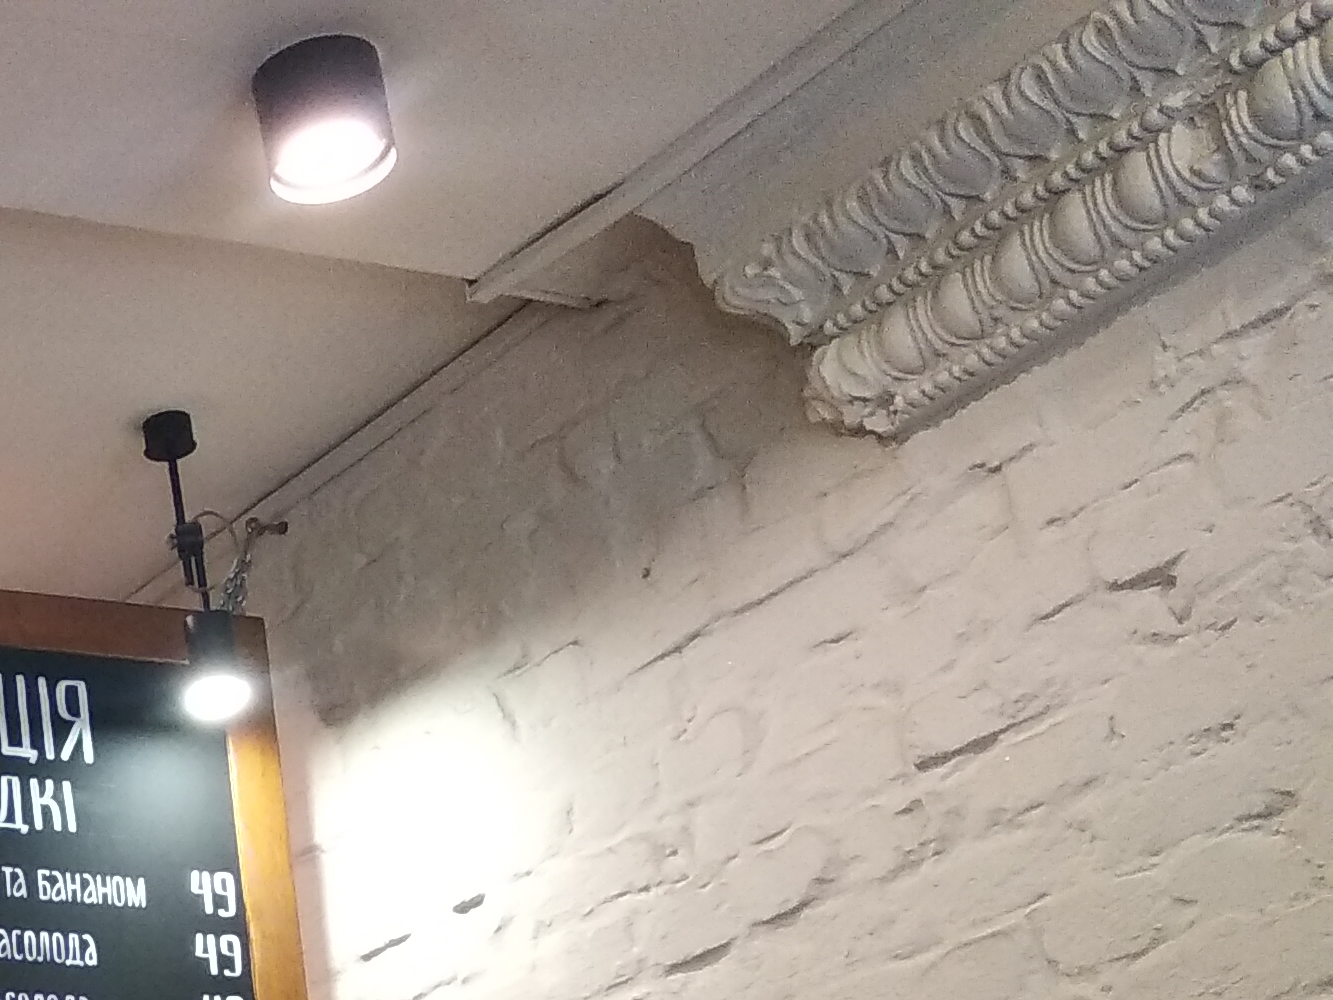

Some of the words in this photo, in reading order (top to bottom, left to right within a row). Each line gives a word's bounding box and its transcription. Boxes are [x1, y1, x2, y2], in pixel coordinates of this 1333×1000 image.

[1, 866, 27, 898] та
[37, 869, 146, 908] бананом
[191, 870, 236, 917] 49
[195, 933, 242, 977] 49
